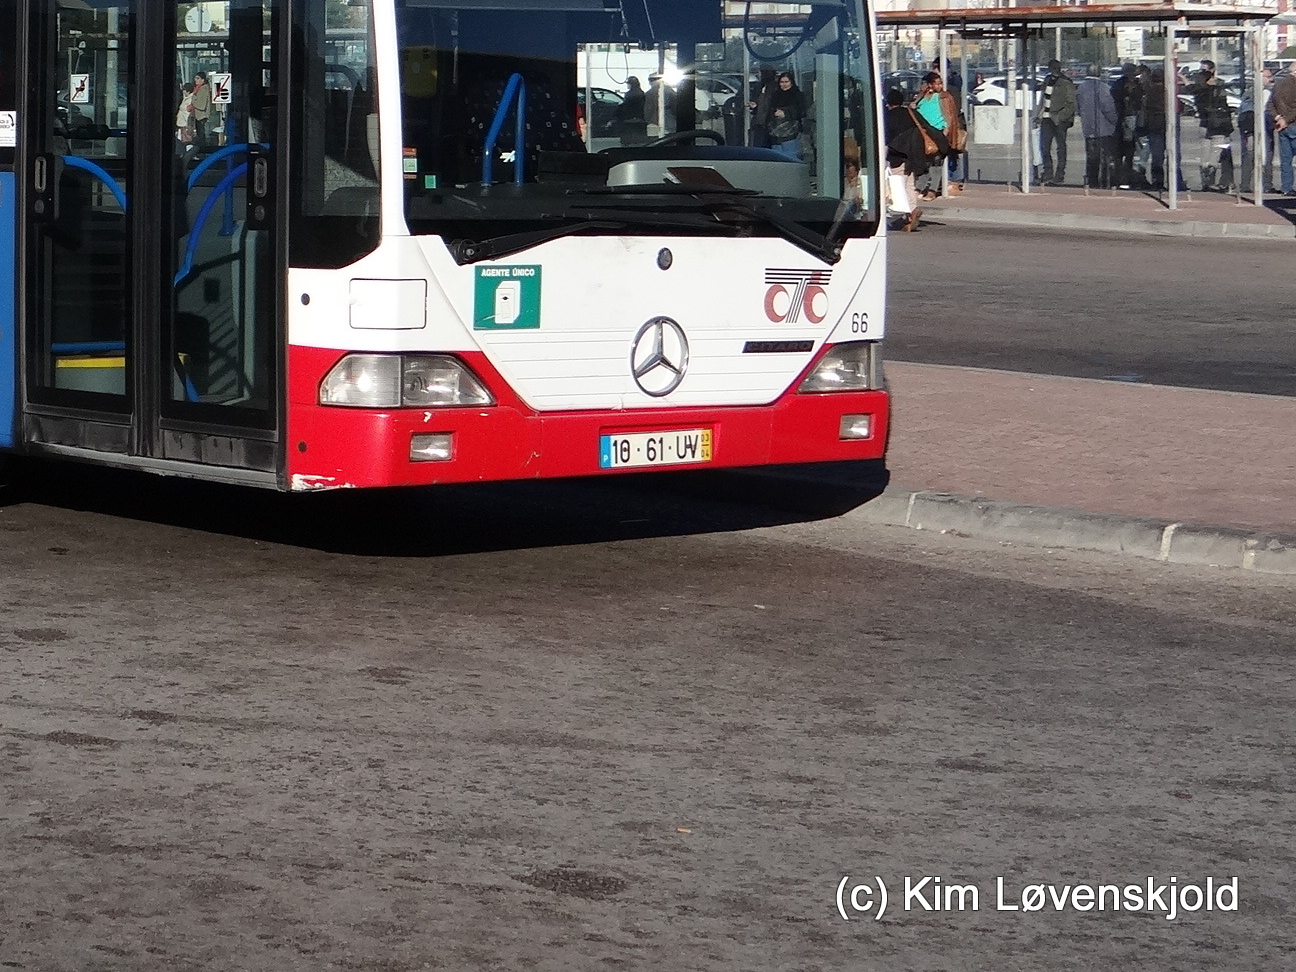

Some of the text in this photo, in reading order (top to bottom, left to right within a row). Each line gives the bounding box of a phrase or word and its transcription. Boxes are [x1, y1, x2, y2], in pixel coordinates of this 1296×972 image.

[481, 267, 535, 277] AGENTE ÚNICO
[851, 312, 869, 333] 66
